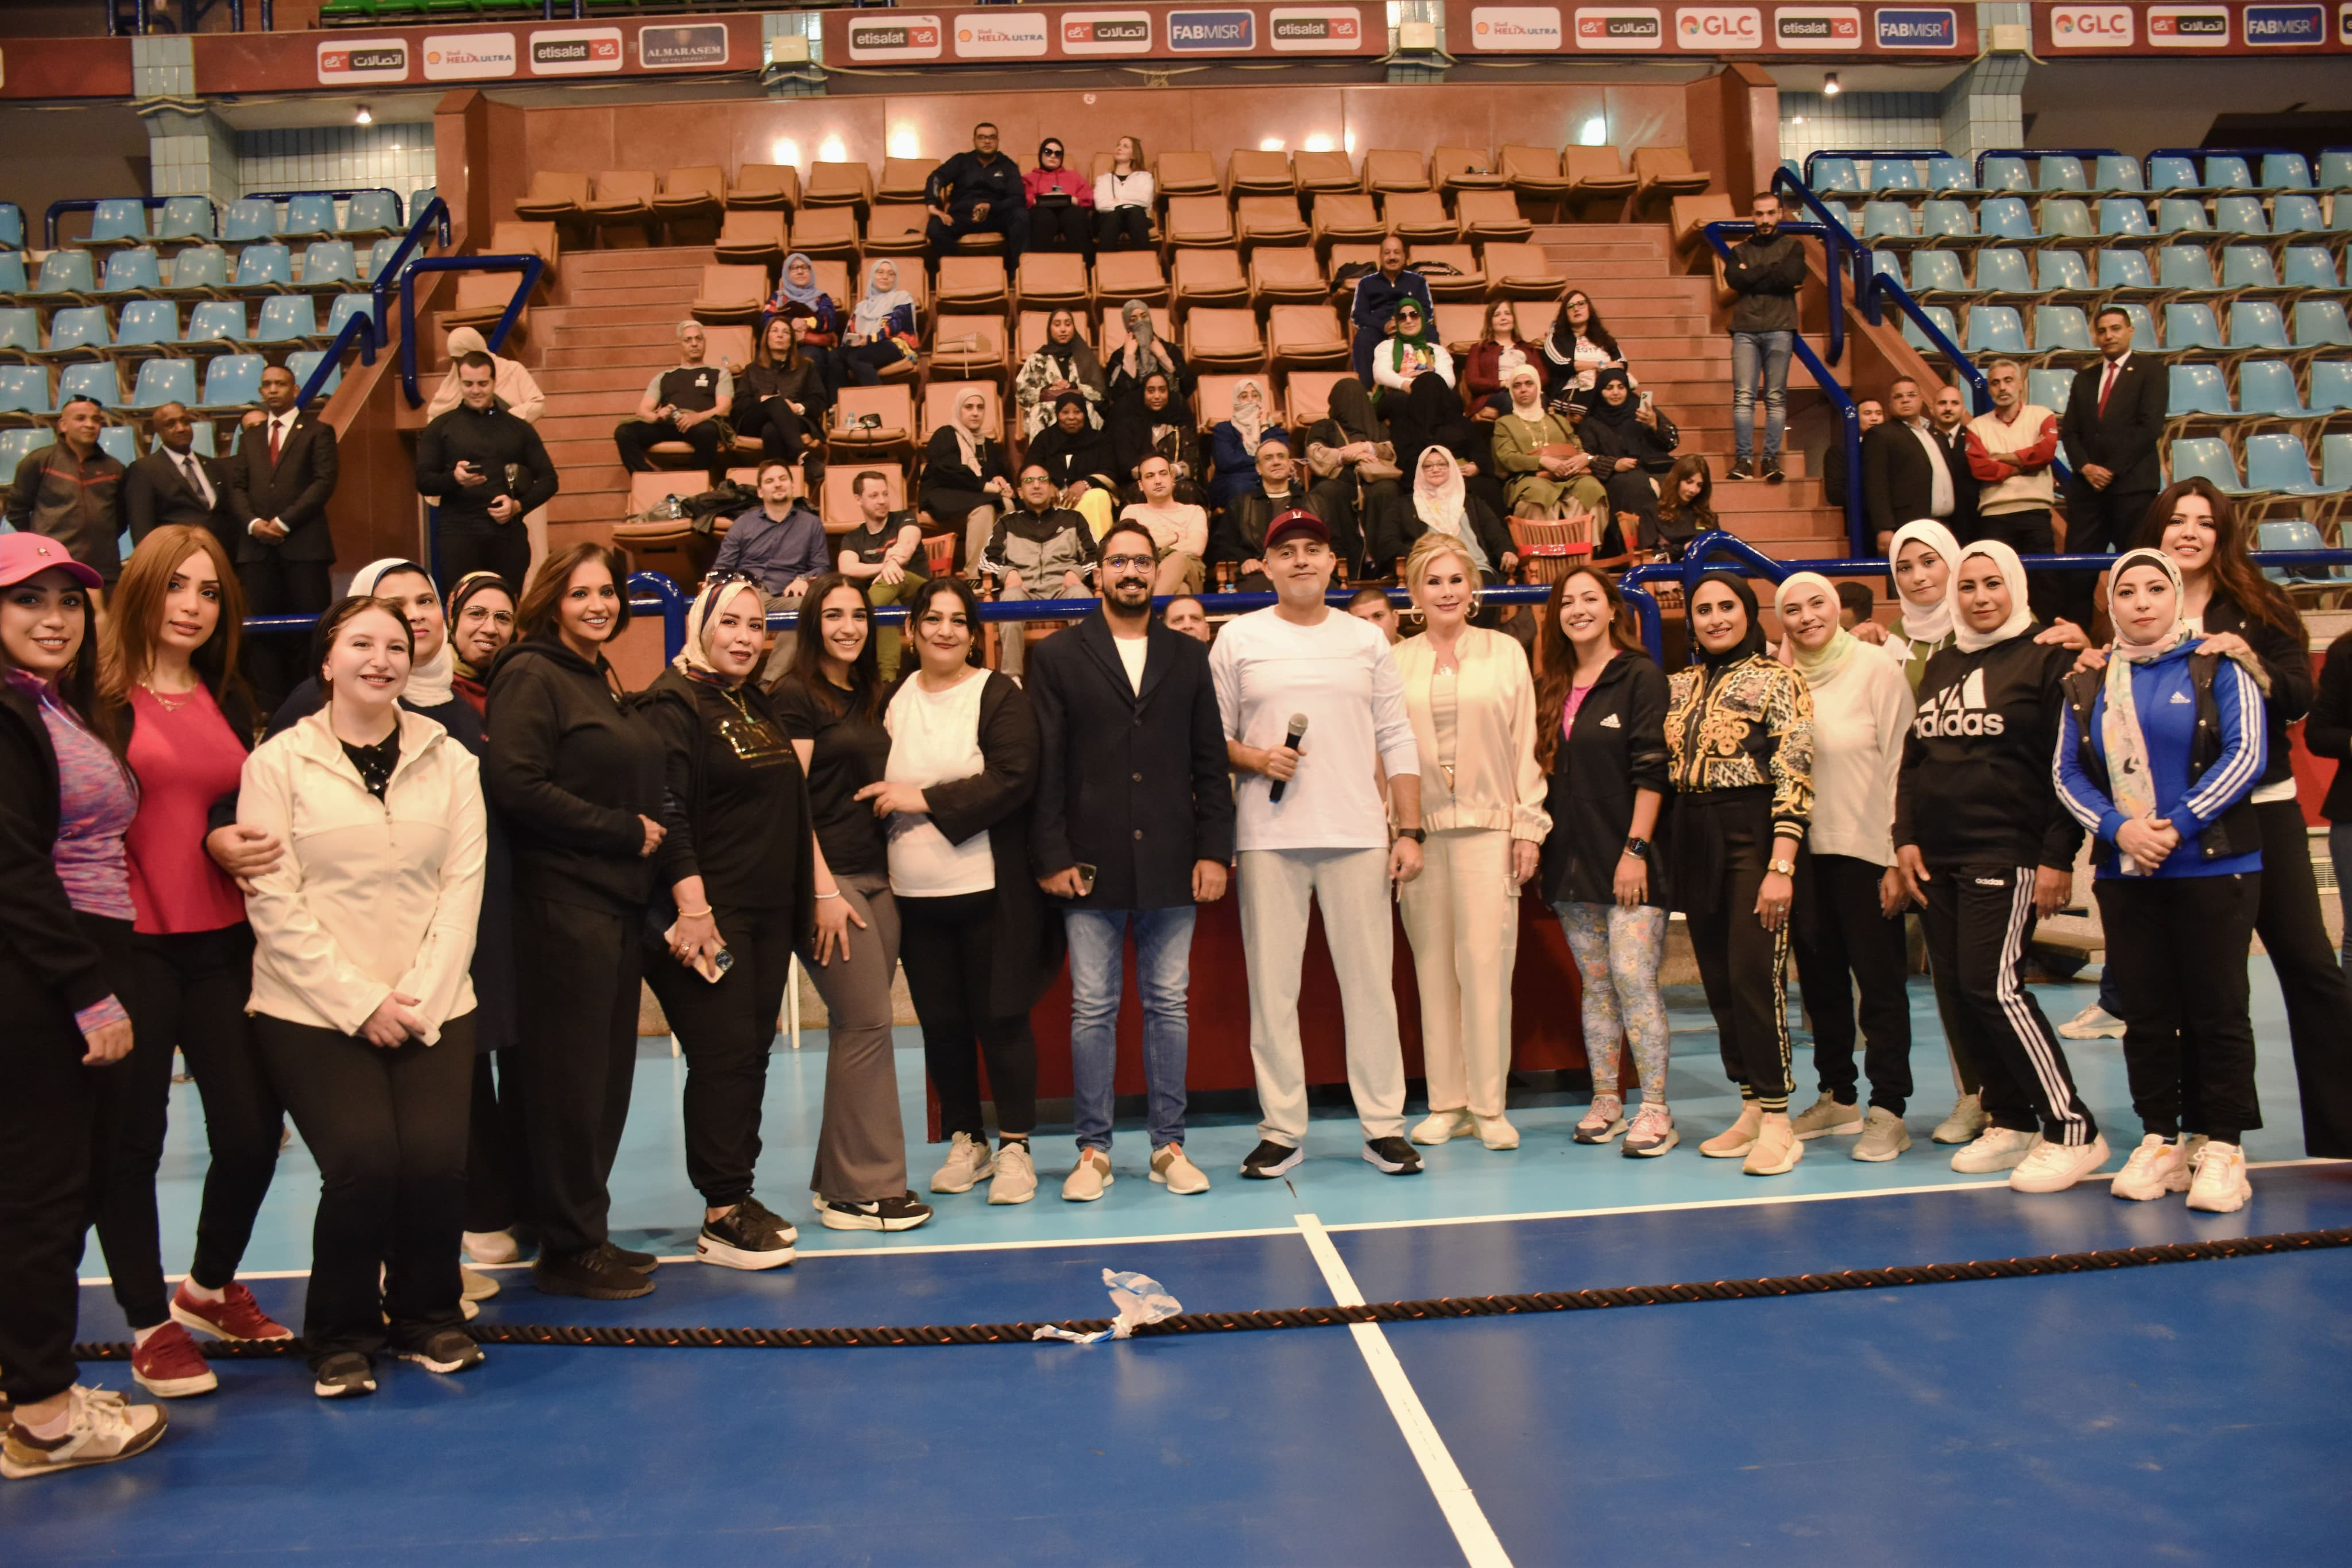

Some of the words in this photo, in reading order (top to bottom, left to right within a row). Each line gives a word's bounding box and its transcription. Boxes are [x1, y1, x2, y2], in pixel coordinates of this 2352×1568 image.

[1278, 23, 1325, 35] etisalat
[1494, 26, 1526, 34] HELIX
[1703, 16, 1754, 36] GLC
[1782, 21, 1828, 34] etisalat
[1880, 23, 1943, 37] FABMISR
[2077, 14, 2126, 33] GLC
[2249, 20, 2311, 34] FABMISR
[856, 32, 905, 44] etisalat
[977, 33, 1010, 42] HELIX
[1173, 25, 1240, 40] FABMISR
[537, 45, 586, 59] etisalat
[647, 46, 721, 57] ALMARASEM
[446, 54, 479, 64] HELIX
[1913, 708, 2005, 740] adidas
